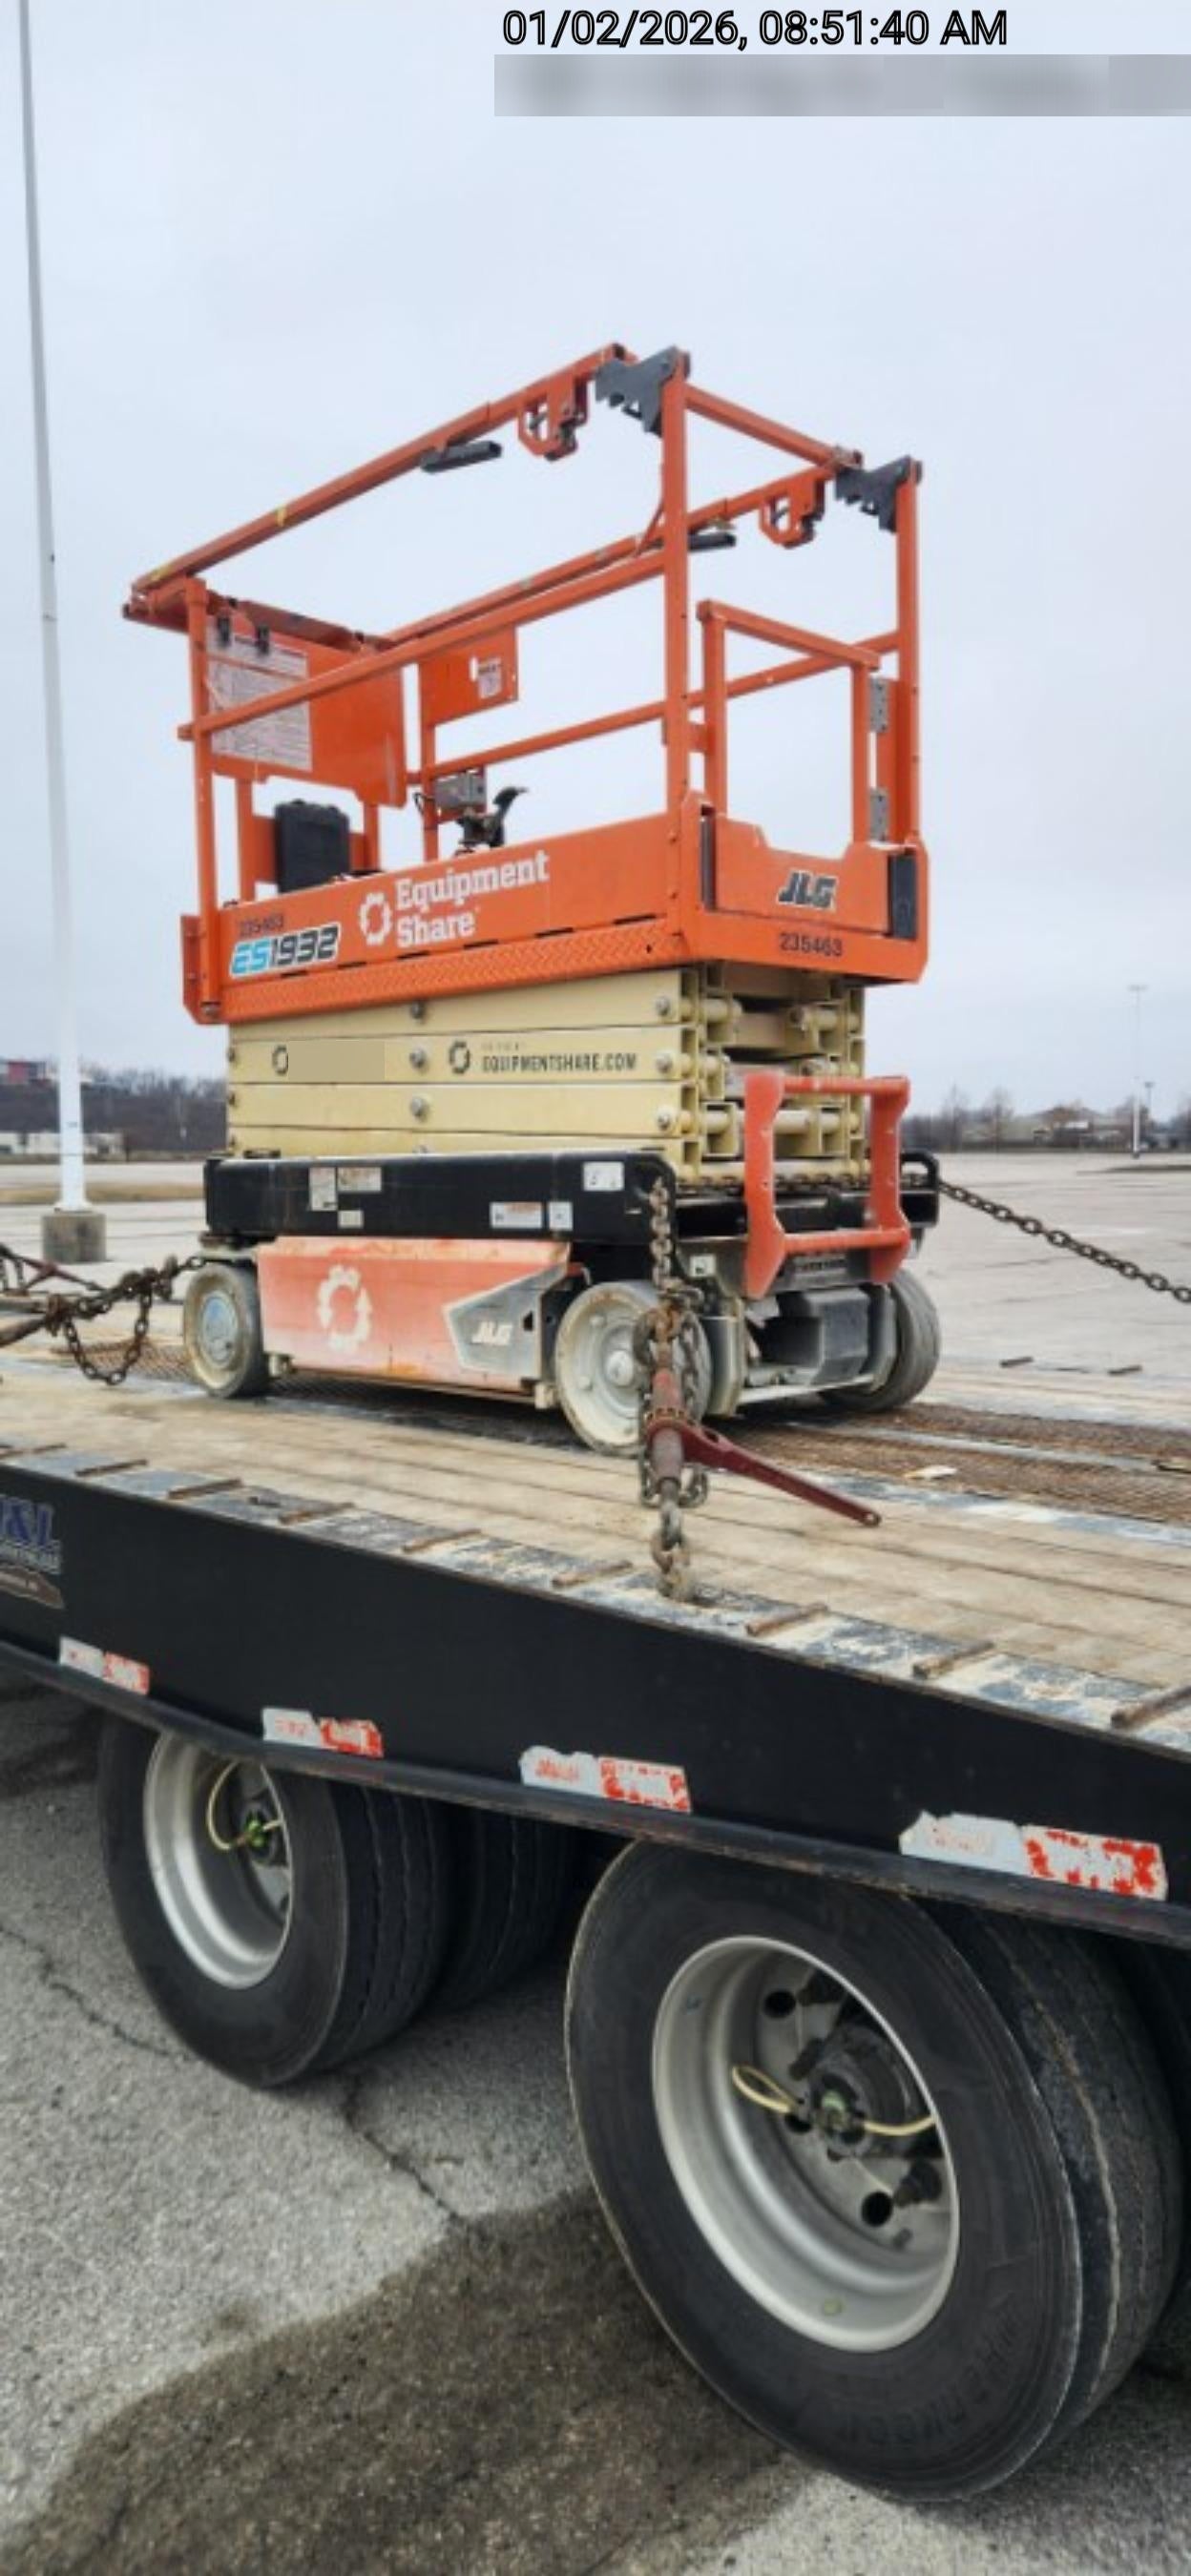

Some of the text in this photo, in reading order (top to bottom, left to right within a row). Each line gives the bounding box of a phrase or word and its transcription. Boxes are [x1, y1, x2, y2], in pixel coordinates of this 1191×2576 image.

[395, 850, 550, 913] Equipment
[778, 869, 837, 912] JLG
[396, 911, 476, 948] Share
[779, 930, 844, 958] 235463
[230, 923, 341, 977] ES1932
[481, 1051, 637, 1073] EQUIPMENTSHARE.COM
